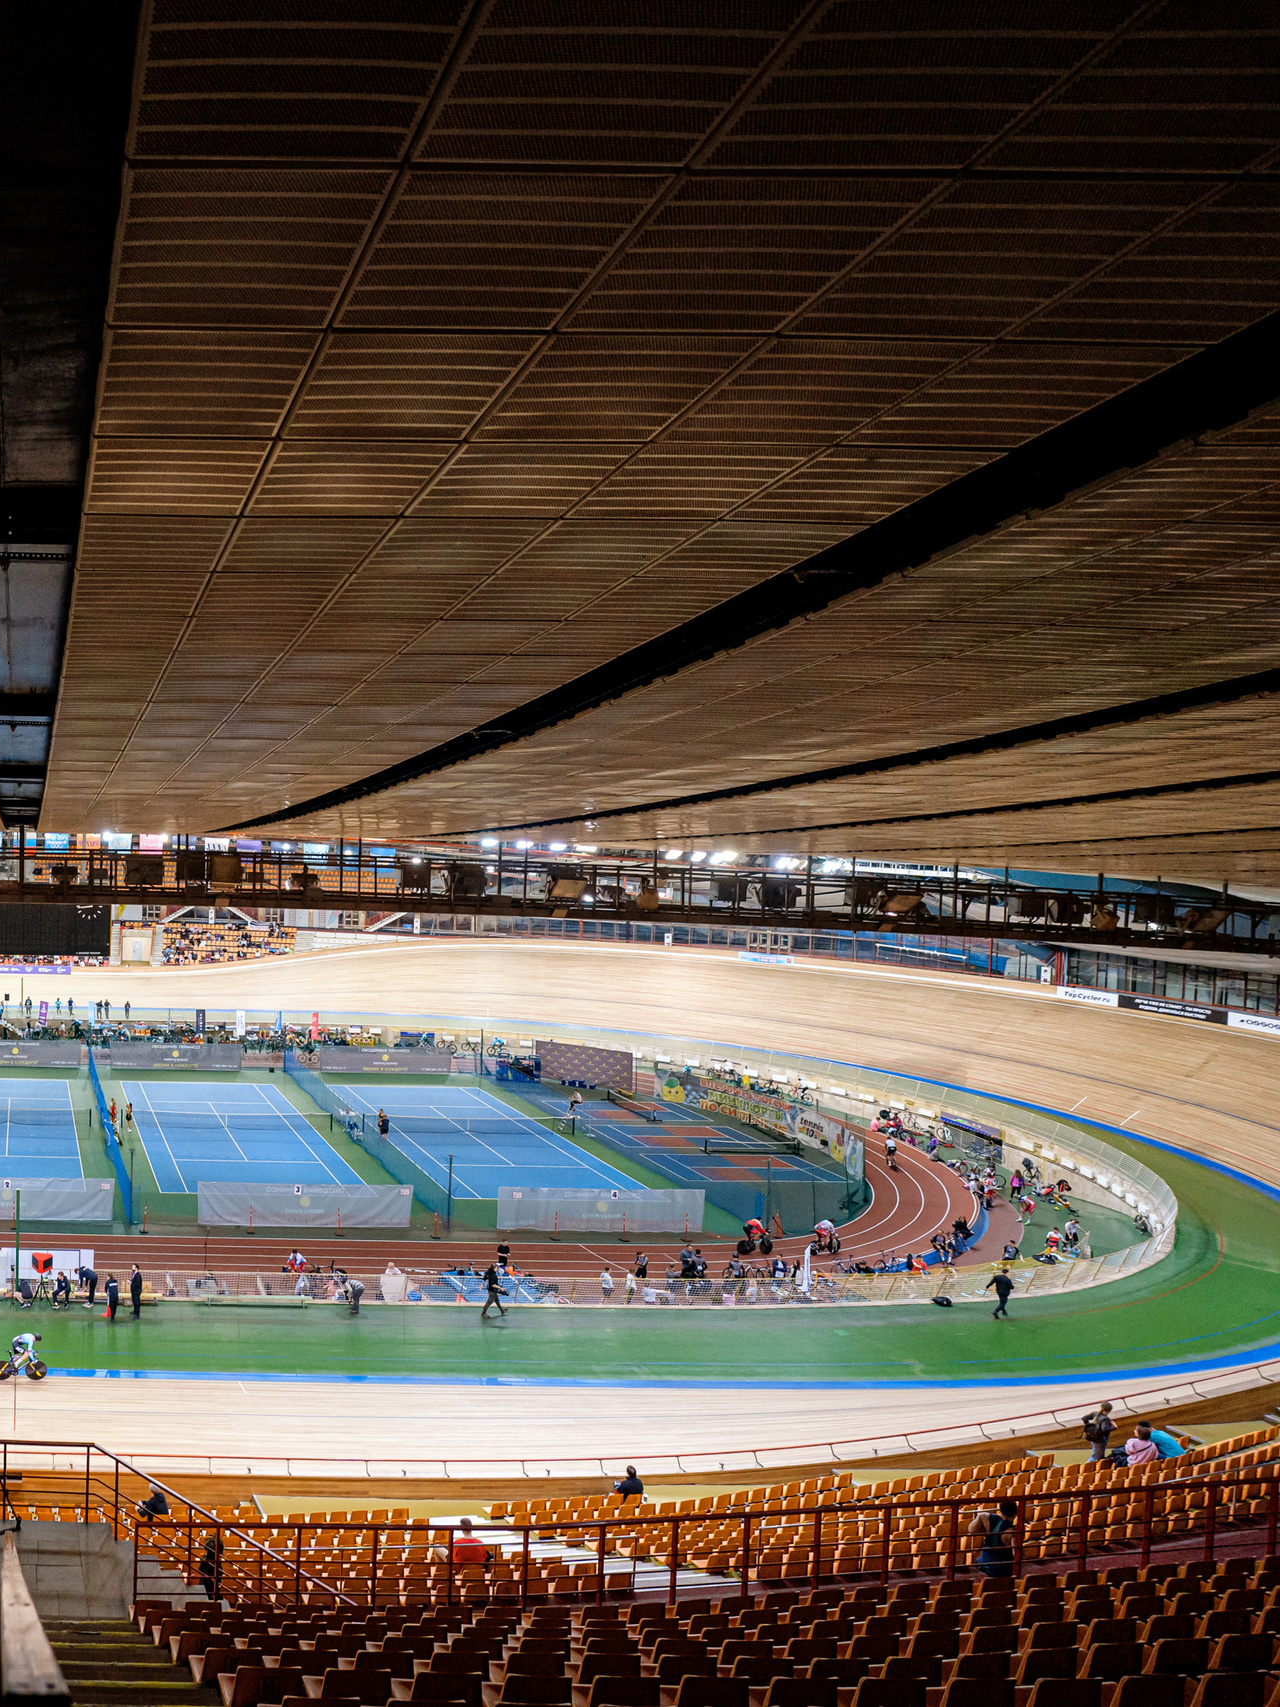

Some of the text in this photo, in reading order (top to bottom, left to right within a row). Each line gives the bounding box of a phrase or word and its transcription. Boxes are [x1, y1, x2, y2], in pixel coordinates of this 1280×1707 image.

[700, 1078, 747, 1098] ВПЕРВЫЕ
[755, 1093, 792, 1112] РОССИИ
[699, 1099, 718, 1112] ПО
[707, 1090, 783, 1121] МИНИ КОРТЫ
[800, 1116, 824, 1133] tennis
[805, 1127, 818, 1140] 10s
